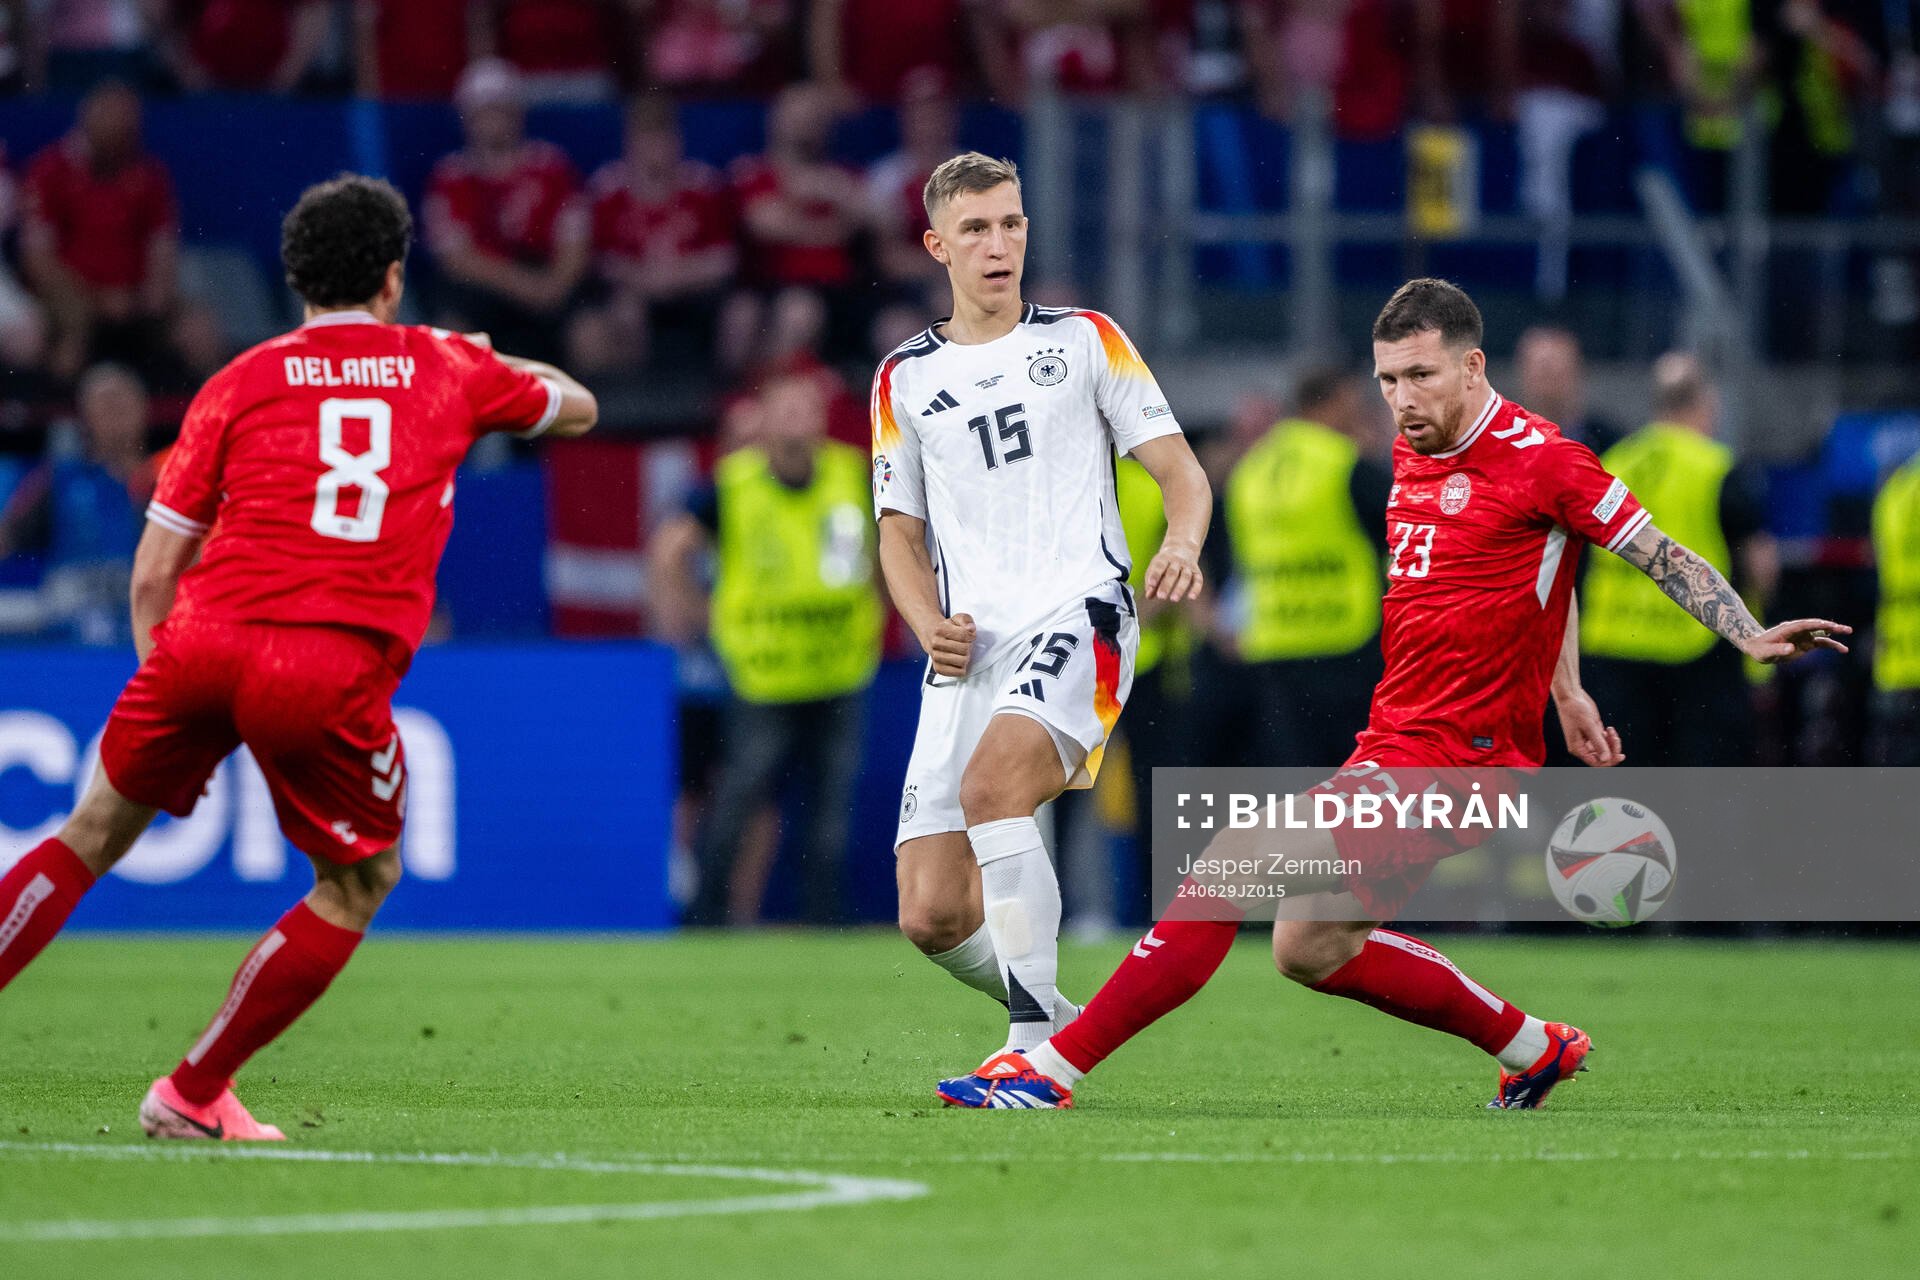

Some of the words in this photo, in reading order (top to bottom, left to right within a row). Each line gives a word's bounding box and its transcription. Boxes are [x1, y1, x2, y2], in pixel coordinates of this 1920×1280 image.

[284, 356, 416, 389] DELANEY
[967, 403, 1034, 471] 15
[310, 397, 392, 542] 8
[1389, 521, 1437, 578] 23
[1014, 631, 1080, 680] 15
